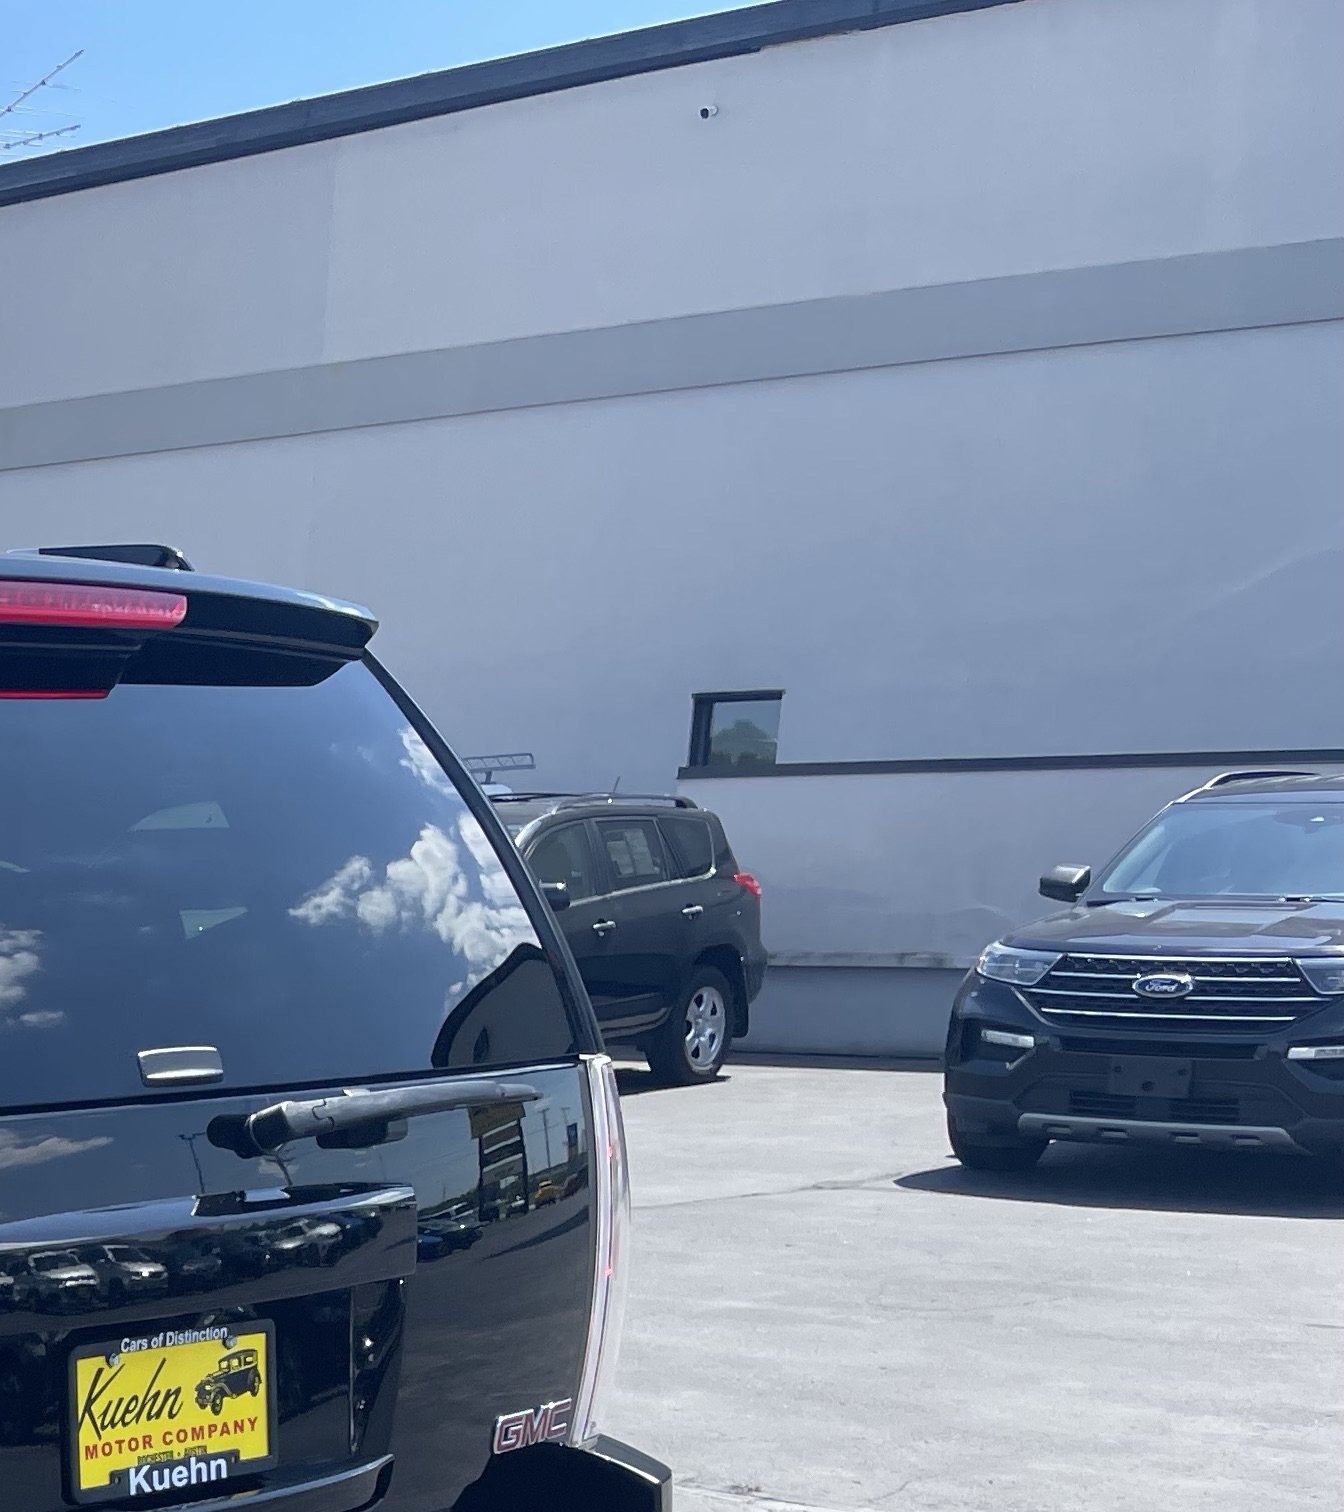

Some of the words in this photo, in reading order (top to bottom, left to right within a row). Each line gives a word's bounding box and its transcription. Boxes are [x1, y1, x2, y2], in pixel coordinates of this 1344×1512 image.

[1145, 980, 1179, 992] Ford
[120, 1338, 148, 1352] Cars
[151, 1332, 164, 1349] of
[166, 1327, 228, 1346] Distinction
[78, 1358, 183, 1440] Kuehn
[84, 1434, 153, 1461] MOTOR
[162, 1416, 258, 1446] COMPANY
[493, 1398, 572, 1454] GMC
[129, 1456, 228, 1496] Kuehn
